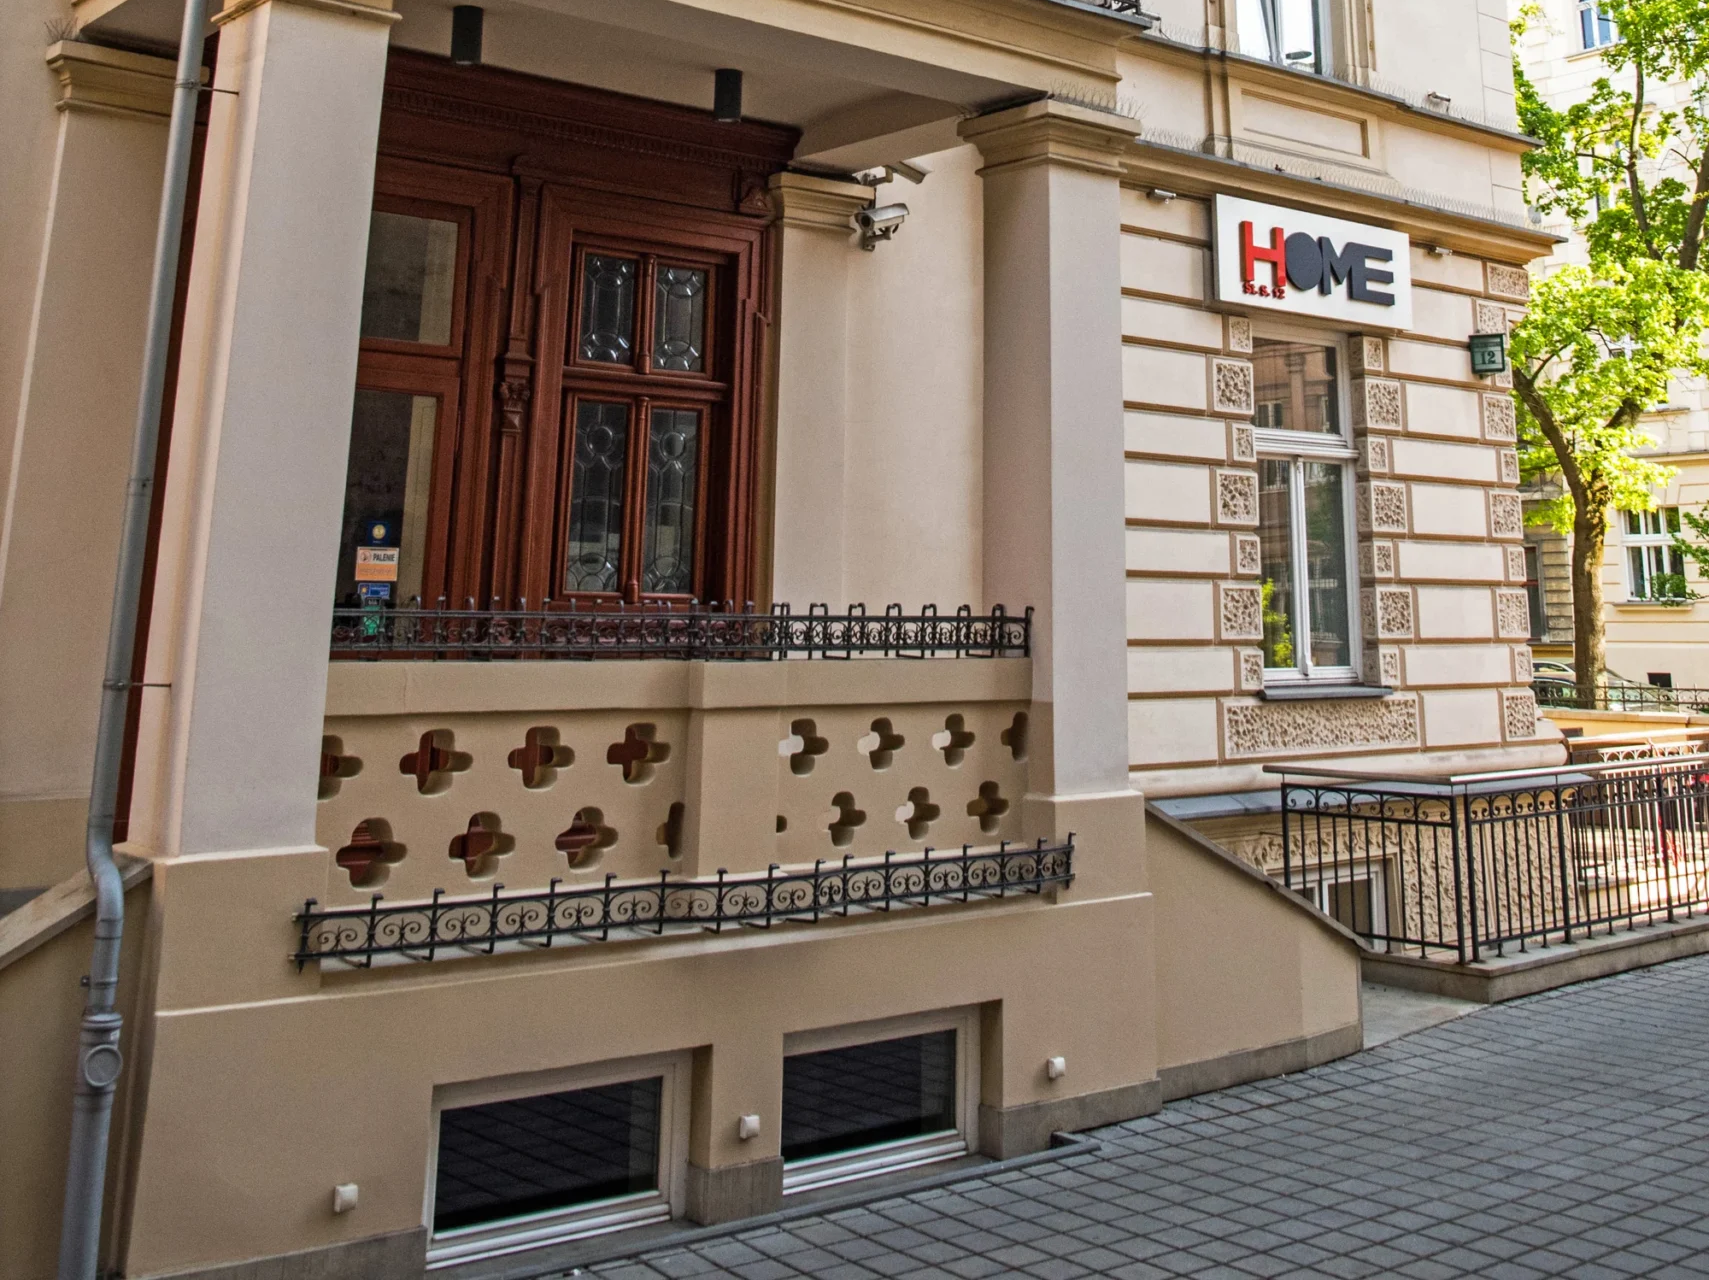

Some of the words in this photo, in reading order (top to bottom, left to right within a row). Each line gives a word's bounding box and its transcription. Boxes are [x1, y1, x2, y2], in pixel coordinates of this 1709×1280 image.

[1239, 220, 1395, 306] HOME
[1480, 350, 1496, 365] 12
[372, 552, 396, 562] PALENIE
